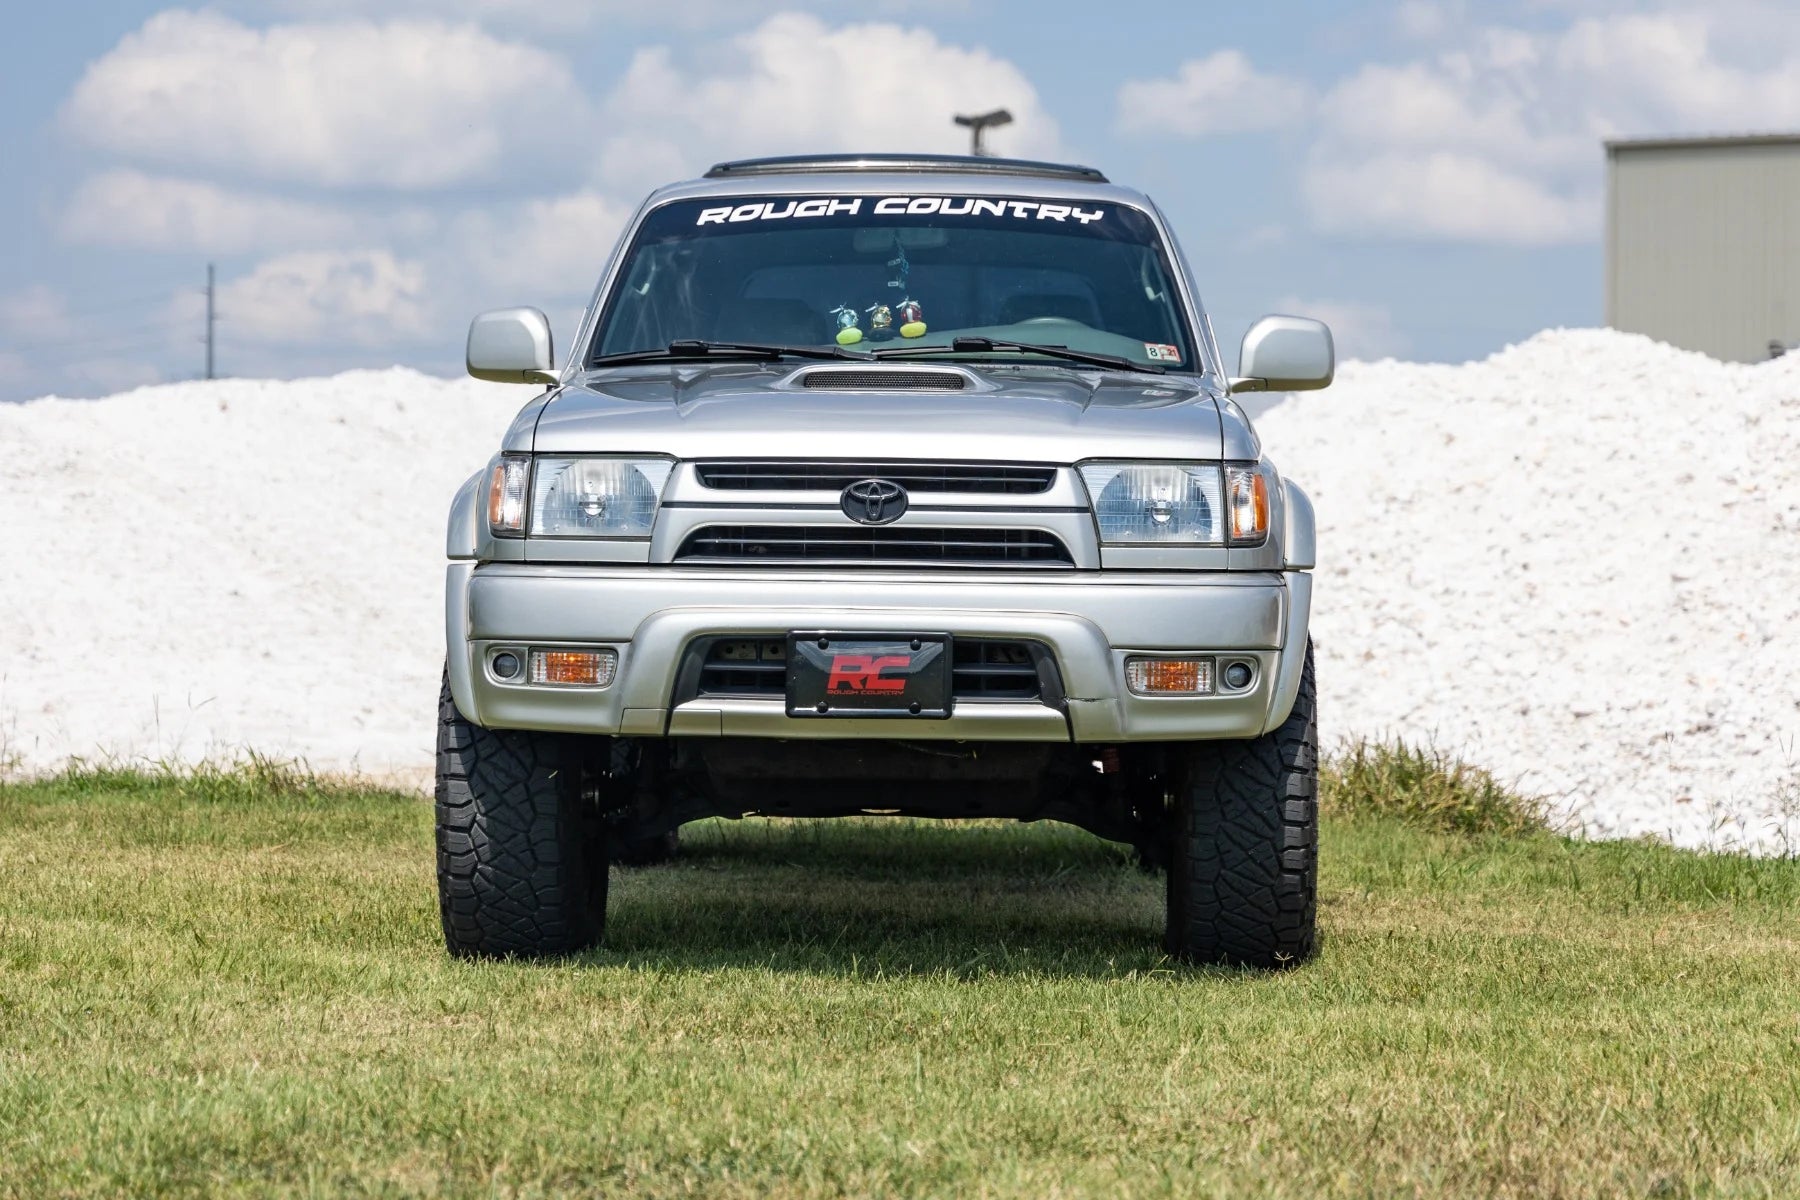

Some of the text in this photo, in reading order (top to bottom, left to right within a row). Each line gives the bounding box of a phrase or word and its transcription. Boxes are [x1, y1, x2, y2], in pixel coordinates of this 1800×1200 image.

[696, 197, 1104, 226] ROUGH COUNTRY
[1149, 347, 1158, 357] 8
[826, 655, 911, 689] RC
